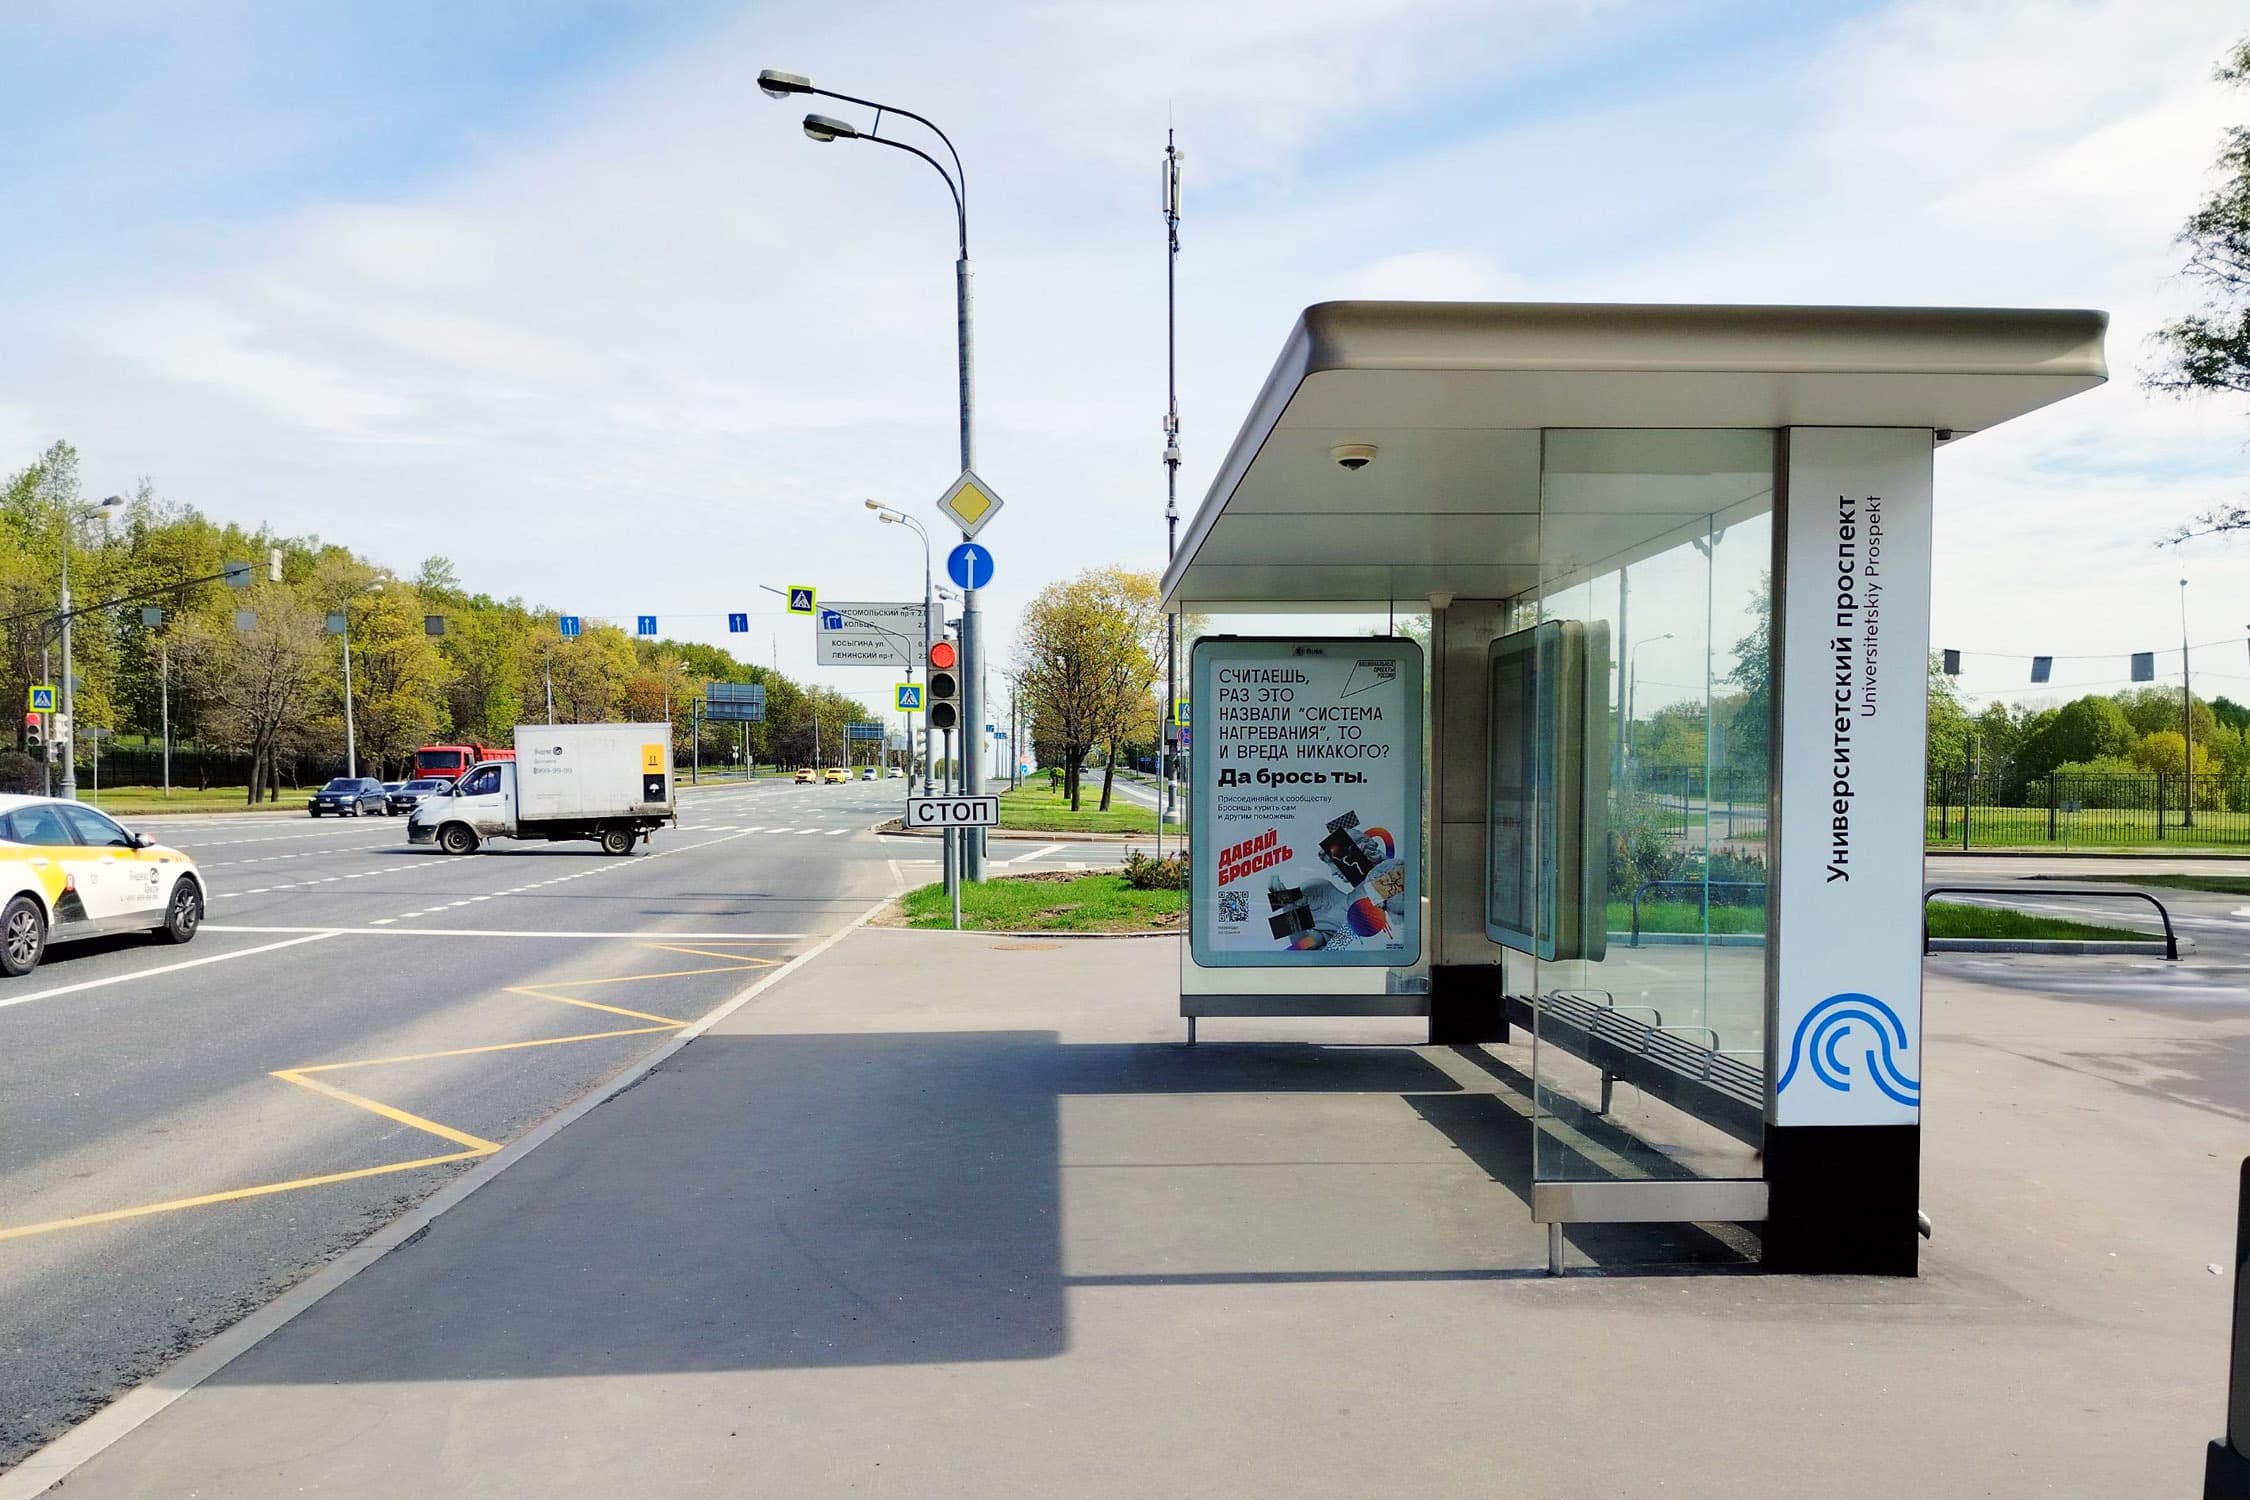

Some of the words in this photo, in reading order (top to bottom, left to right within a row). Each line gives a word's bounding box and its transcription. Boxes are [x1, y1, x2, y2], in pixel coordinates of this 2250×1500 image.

[1865, 495, 1883, 576] Prospekt
[1837, 495, 1859, 627] проспект
[832, 651, 877, 659] ЛЕНИНСКИЙ
[1861, 583, 1883, 717] Universitetskiy
[1219, 669, 1310, 685] СЧИТАЕШЬ,
[1219, 688, 1249, 702] РАЗ
[1258, 688, 1294, 702] ЭТО
[1219, 707, 1290, 721] НАЗВАЛИ
[1338, 726, 1362, 740] ТО
[1219, 745, 1228, 758] И
[1237, 745, 1288, 761] ВРЕДА
[1297, 744, 1390, 759] НИКАКОГО?
[1827, 637, 1855, 883] Университетский
[1218, 768, 1252, 787] Да
[1256, 768, 1327, 788] брось
[1331, 771, 1367, 784] ты.
[1218, 795, 1278, 803] Присоединяйся
[918, 802, 988, 822] СТОП
[1218, 804, 1252, 812] Бросишь
[1254, 805, 1280, 813] курить
[1224, 814, 1252, 822] другим
[1218, 828, 1278, 869] ДАВАЙ
[1218, 845, 1293, 887] БРОСАТЬ
